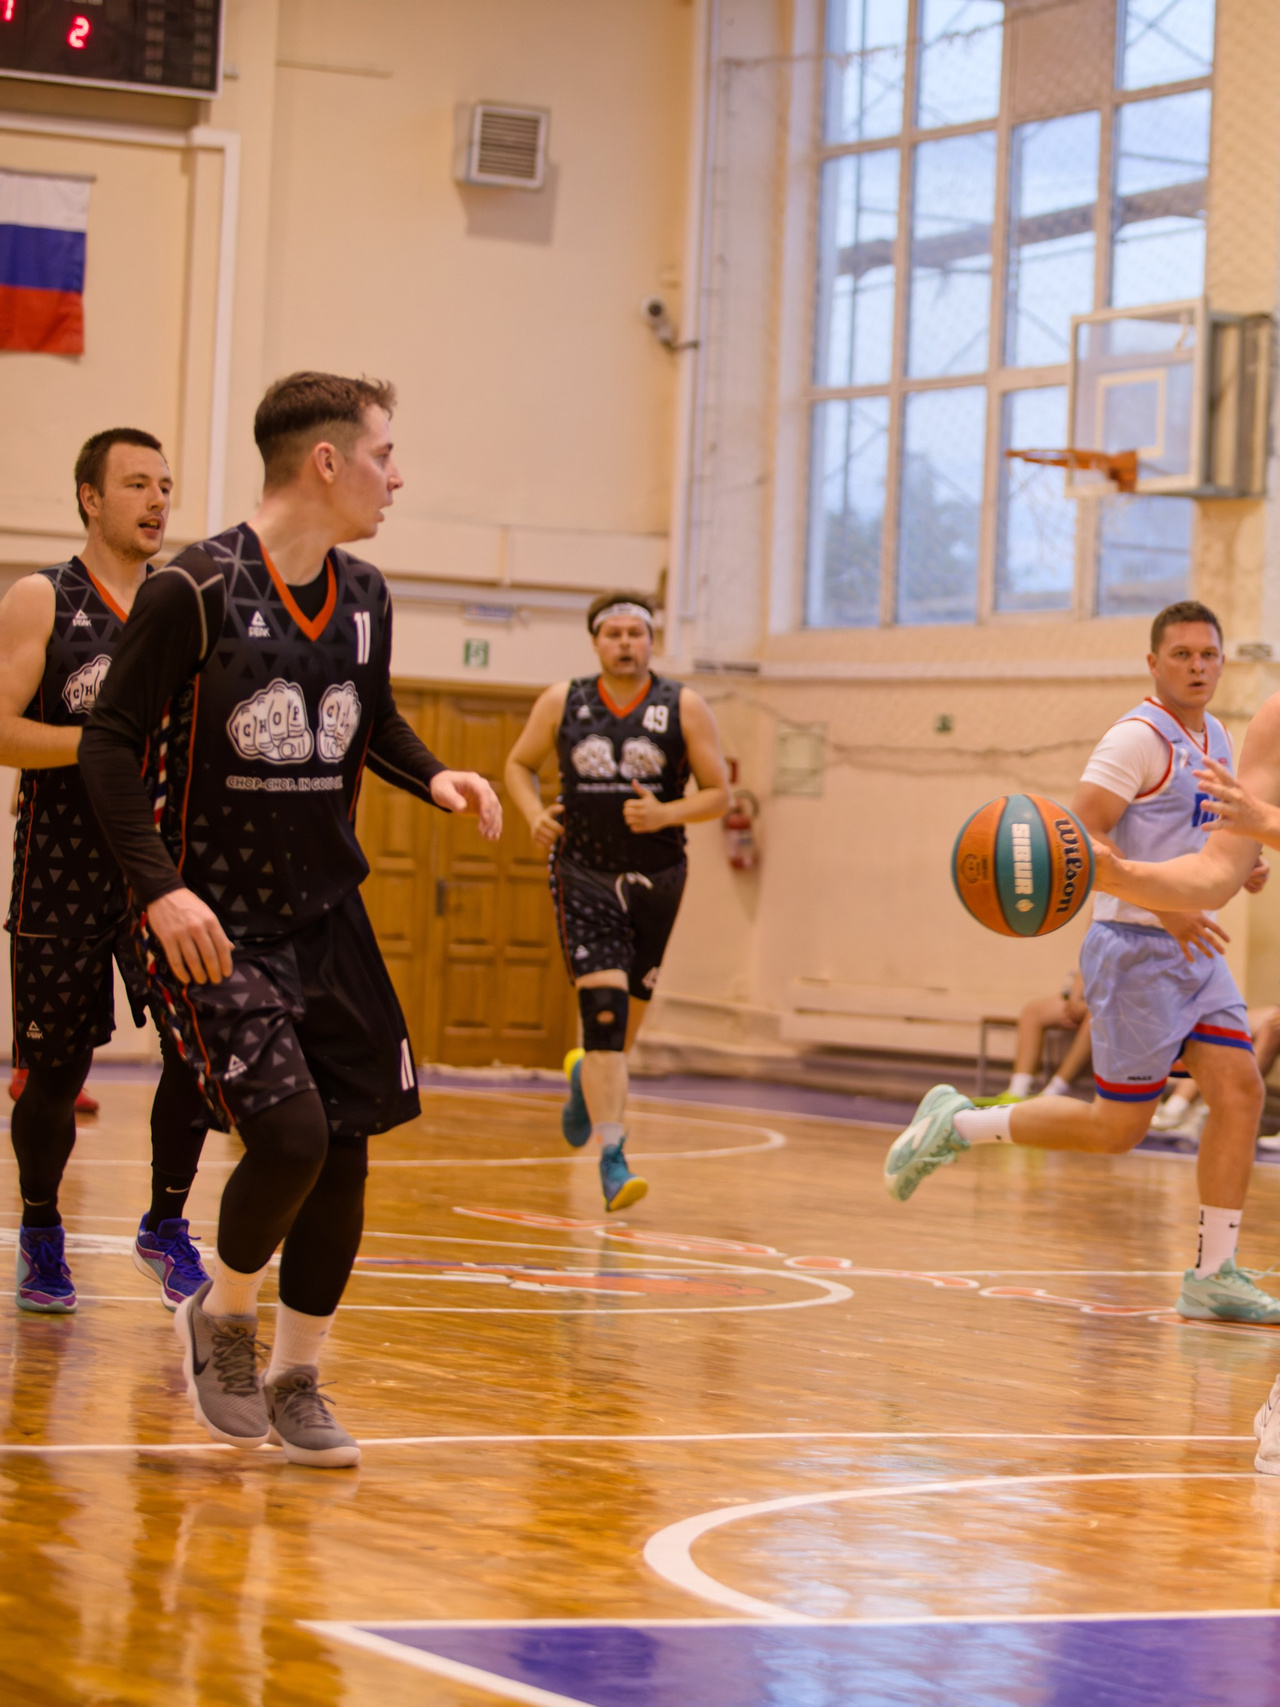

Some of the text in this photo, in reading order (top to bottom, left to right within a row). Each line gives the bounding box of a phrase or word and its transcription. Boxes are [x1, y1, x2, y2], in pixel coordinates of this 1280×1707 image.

[68, 15, 90, 49] 2
[354, 611, 371, 665] 11
[243, 705, 300, 737] CHOP
[642, 705, 669, 733] 49
[298, 777, 311, 791] IN
[1011, 823, 1034, 895] SIBUR
[1054, 818, 1083, 914] Wilson
